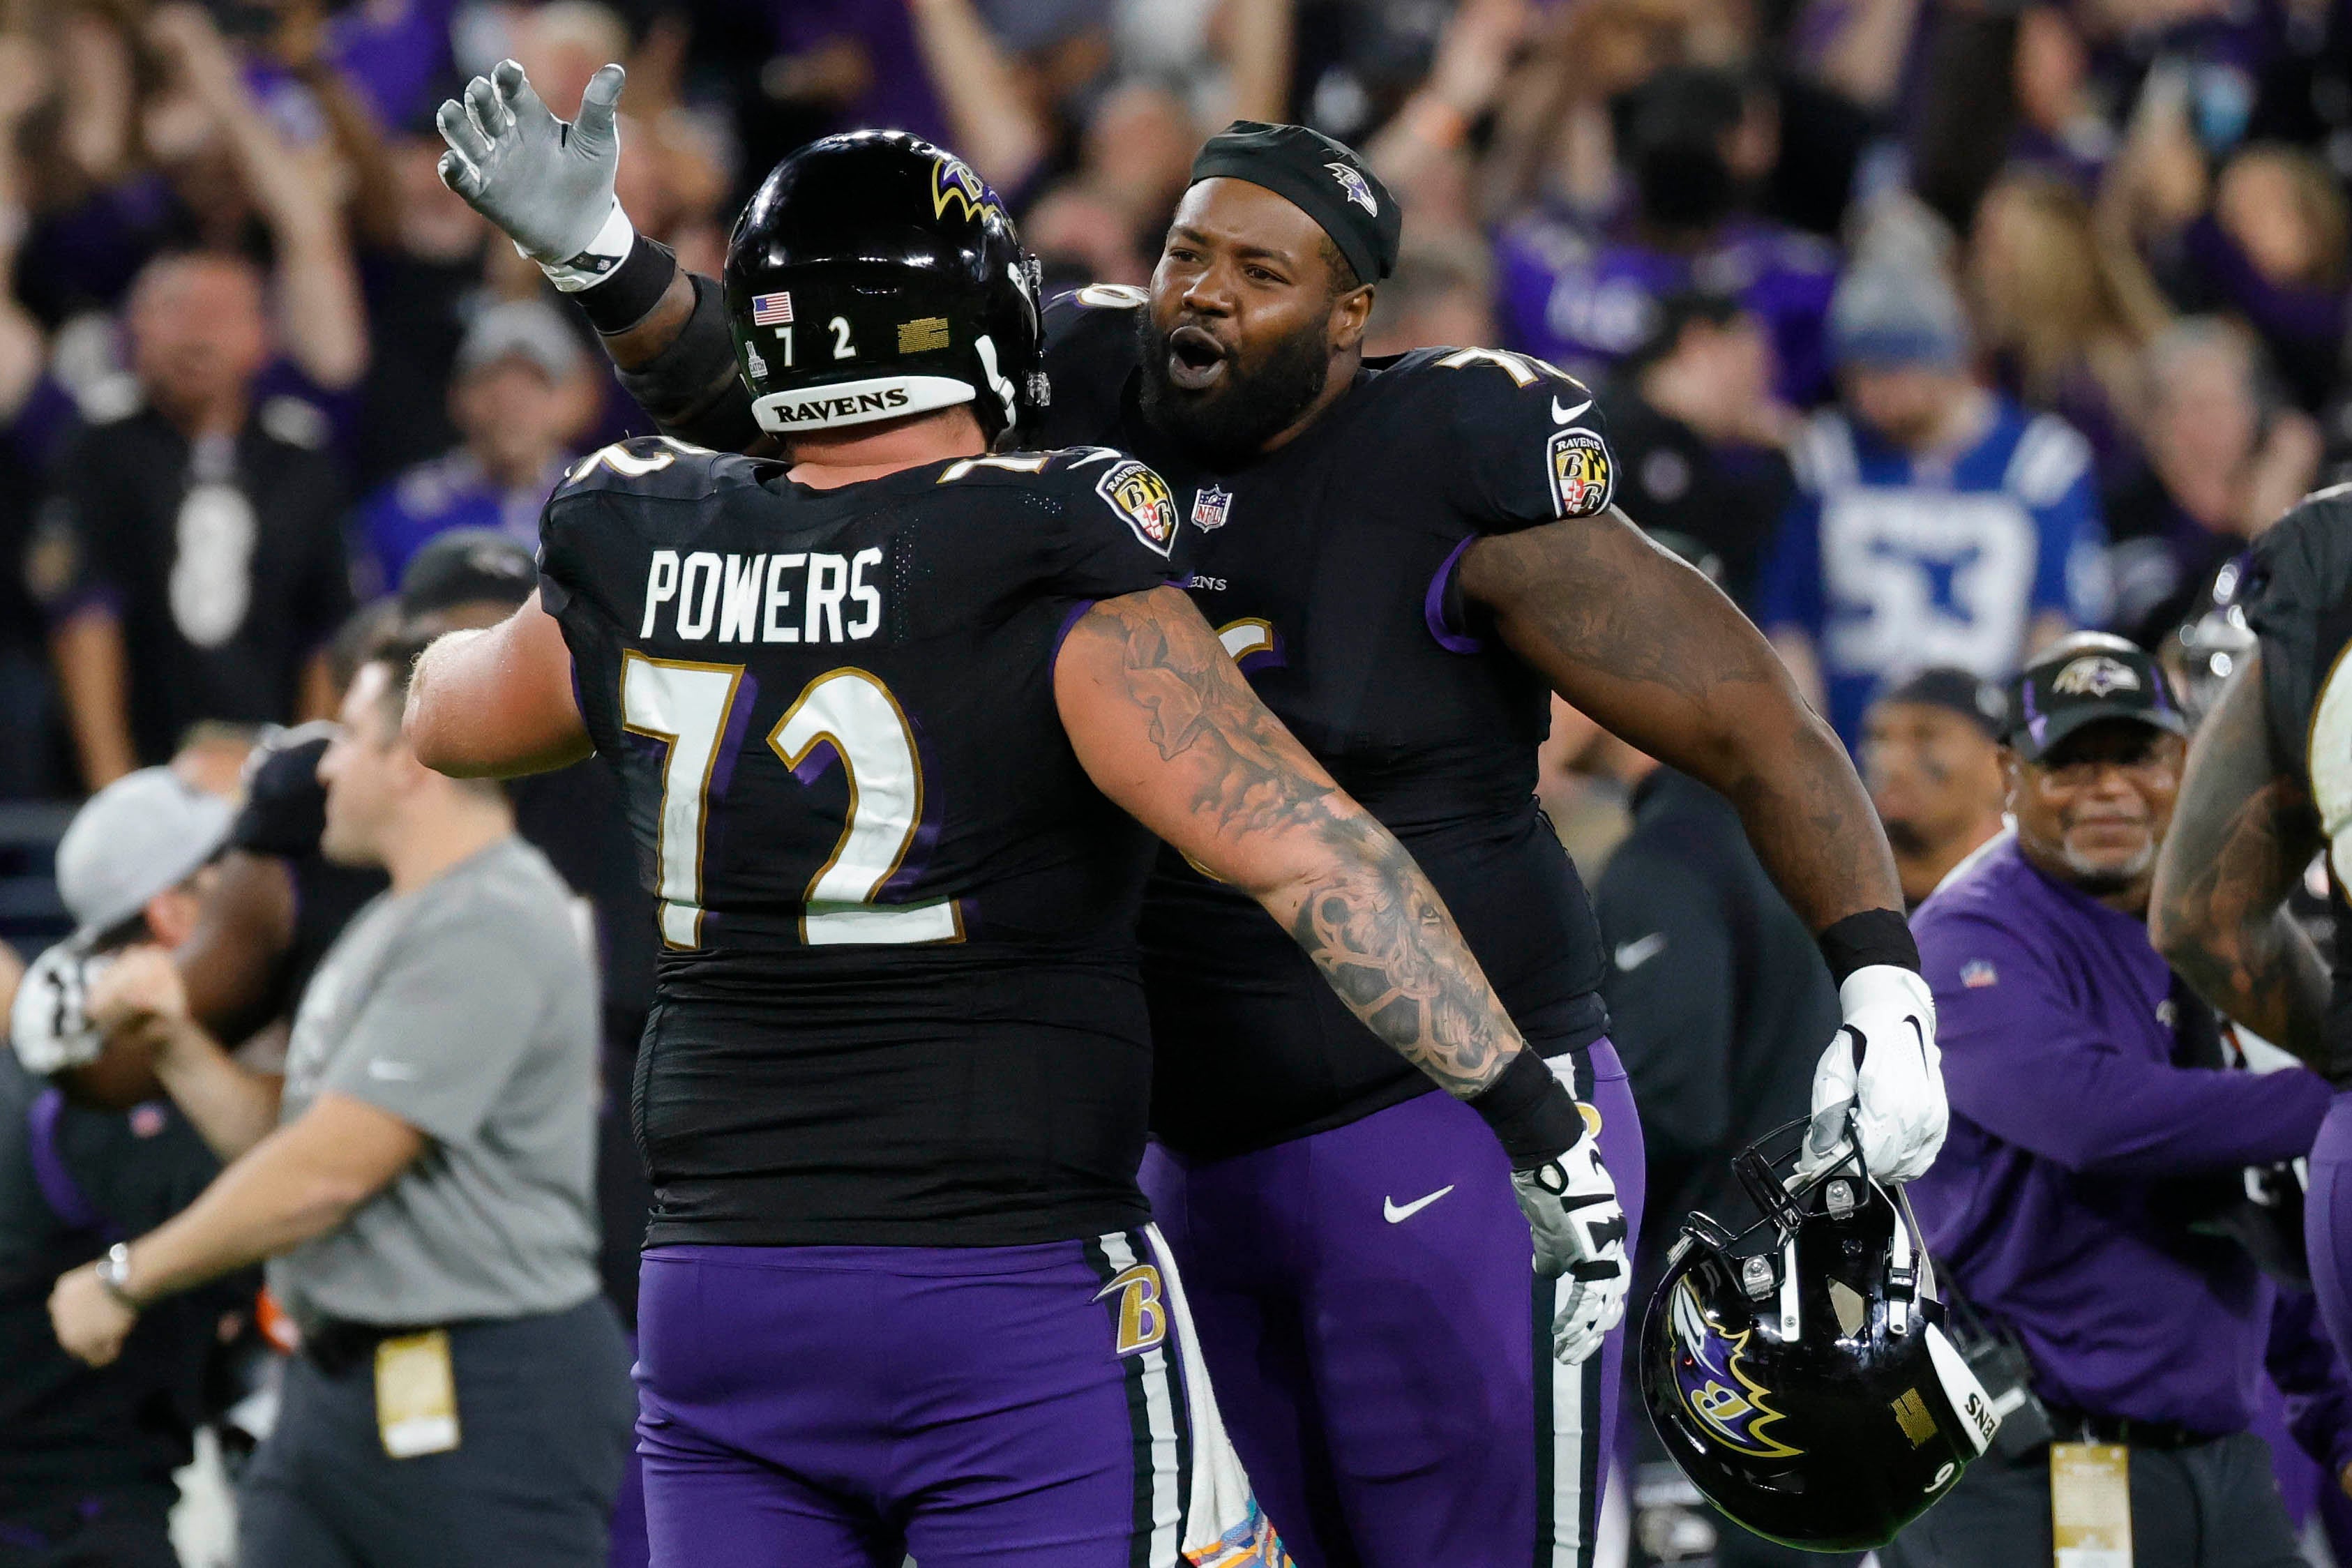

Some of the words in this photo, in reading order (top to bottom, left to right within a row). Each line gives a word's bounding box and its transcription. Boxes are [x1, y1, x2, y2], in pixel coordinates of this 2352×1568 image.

[775, 326, 792, 367] 7
[828, 316, 857, 359] 2
[771, 388, 909, 423] RAVENS
[1555, 437, 1601, 451] RAVENS
[1106, 465, 1146, 492] RAVENS
[1197, 504, 1221, 525] NFL
[640, 547, 882, 643] POWERS
[1820, 483, 2040, 684] 53
[620, 649, 967, 950] 72
